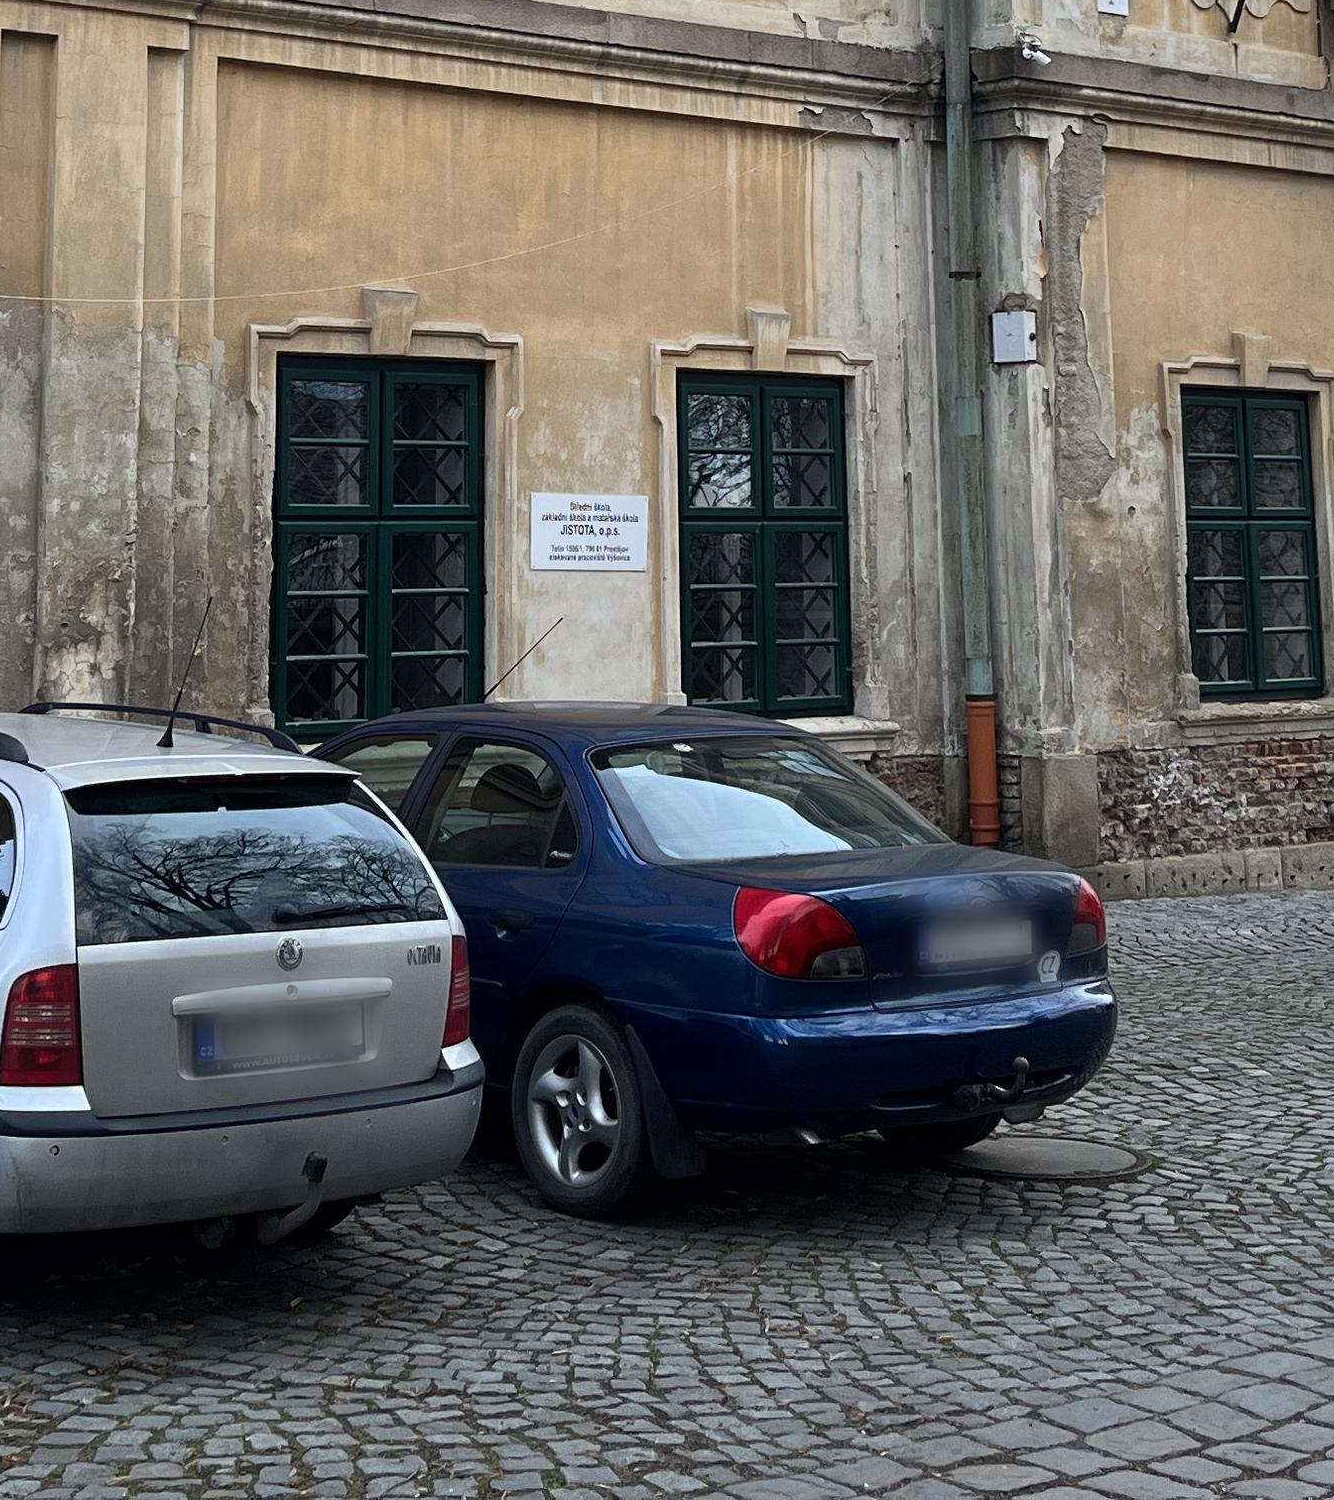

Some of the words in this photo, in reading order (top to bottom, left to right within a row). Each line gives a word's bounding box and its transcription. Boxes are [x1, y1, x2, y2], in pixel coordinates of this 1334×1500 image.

[560, 524, 596, 537] JISTOTA,
[599, 527, 620, 538] o.p.s.
[407, 944, 441, 966] OCTAVIA
[1042, 955, 1056, 974] CZ
[200, 1046, 213, 1057] CZ
